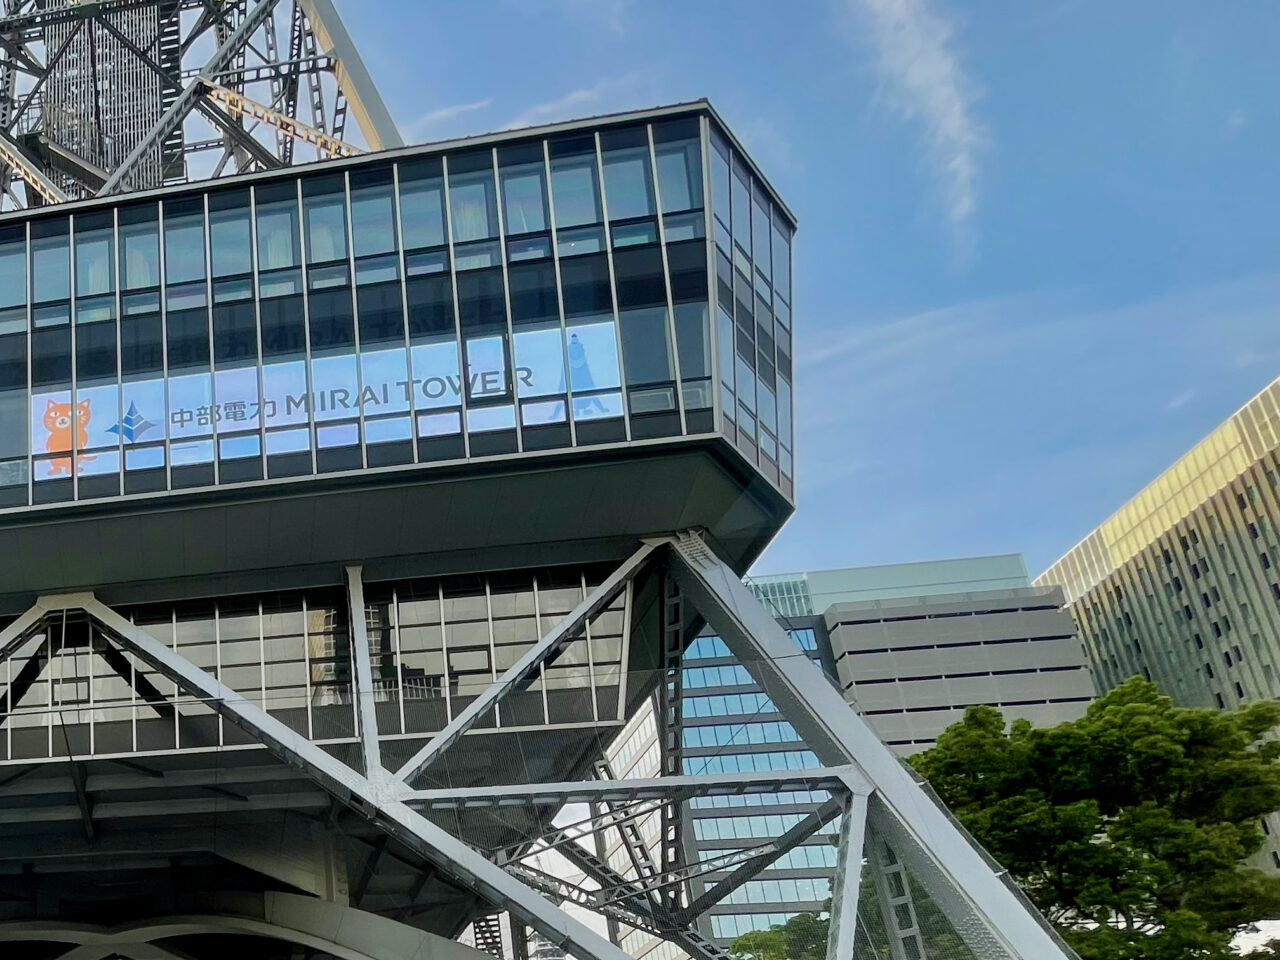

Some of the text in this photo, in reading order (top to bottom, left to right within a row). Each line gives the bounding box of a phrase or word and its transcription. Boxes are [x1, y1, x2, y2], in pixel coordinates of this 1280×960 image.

[171, 366, 534, 428] 中部電力 MIRAI TOWER
